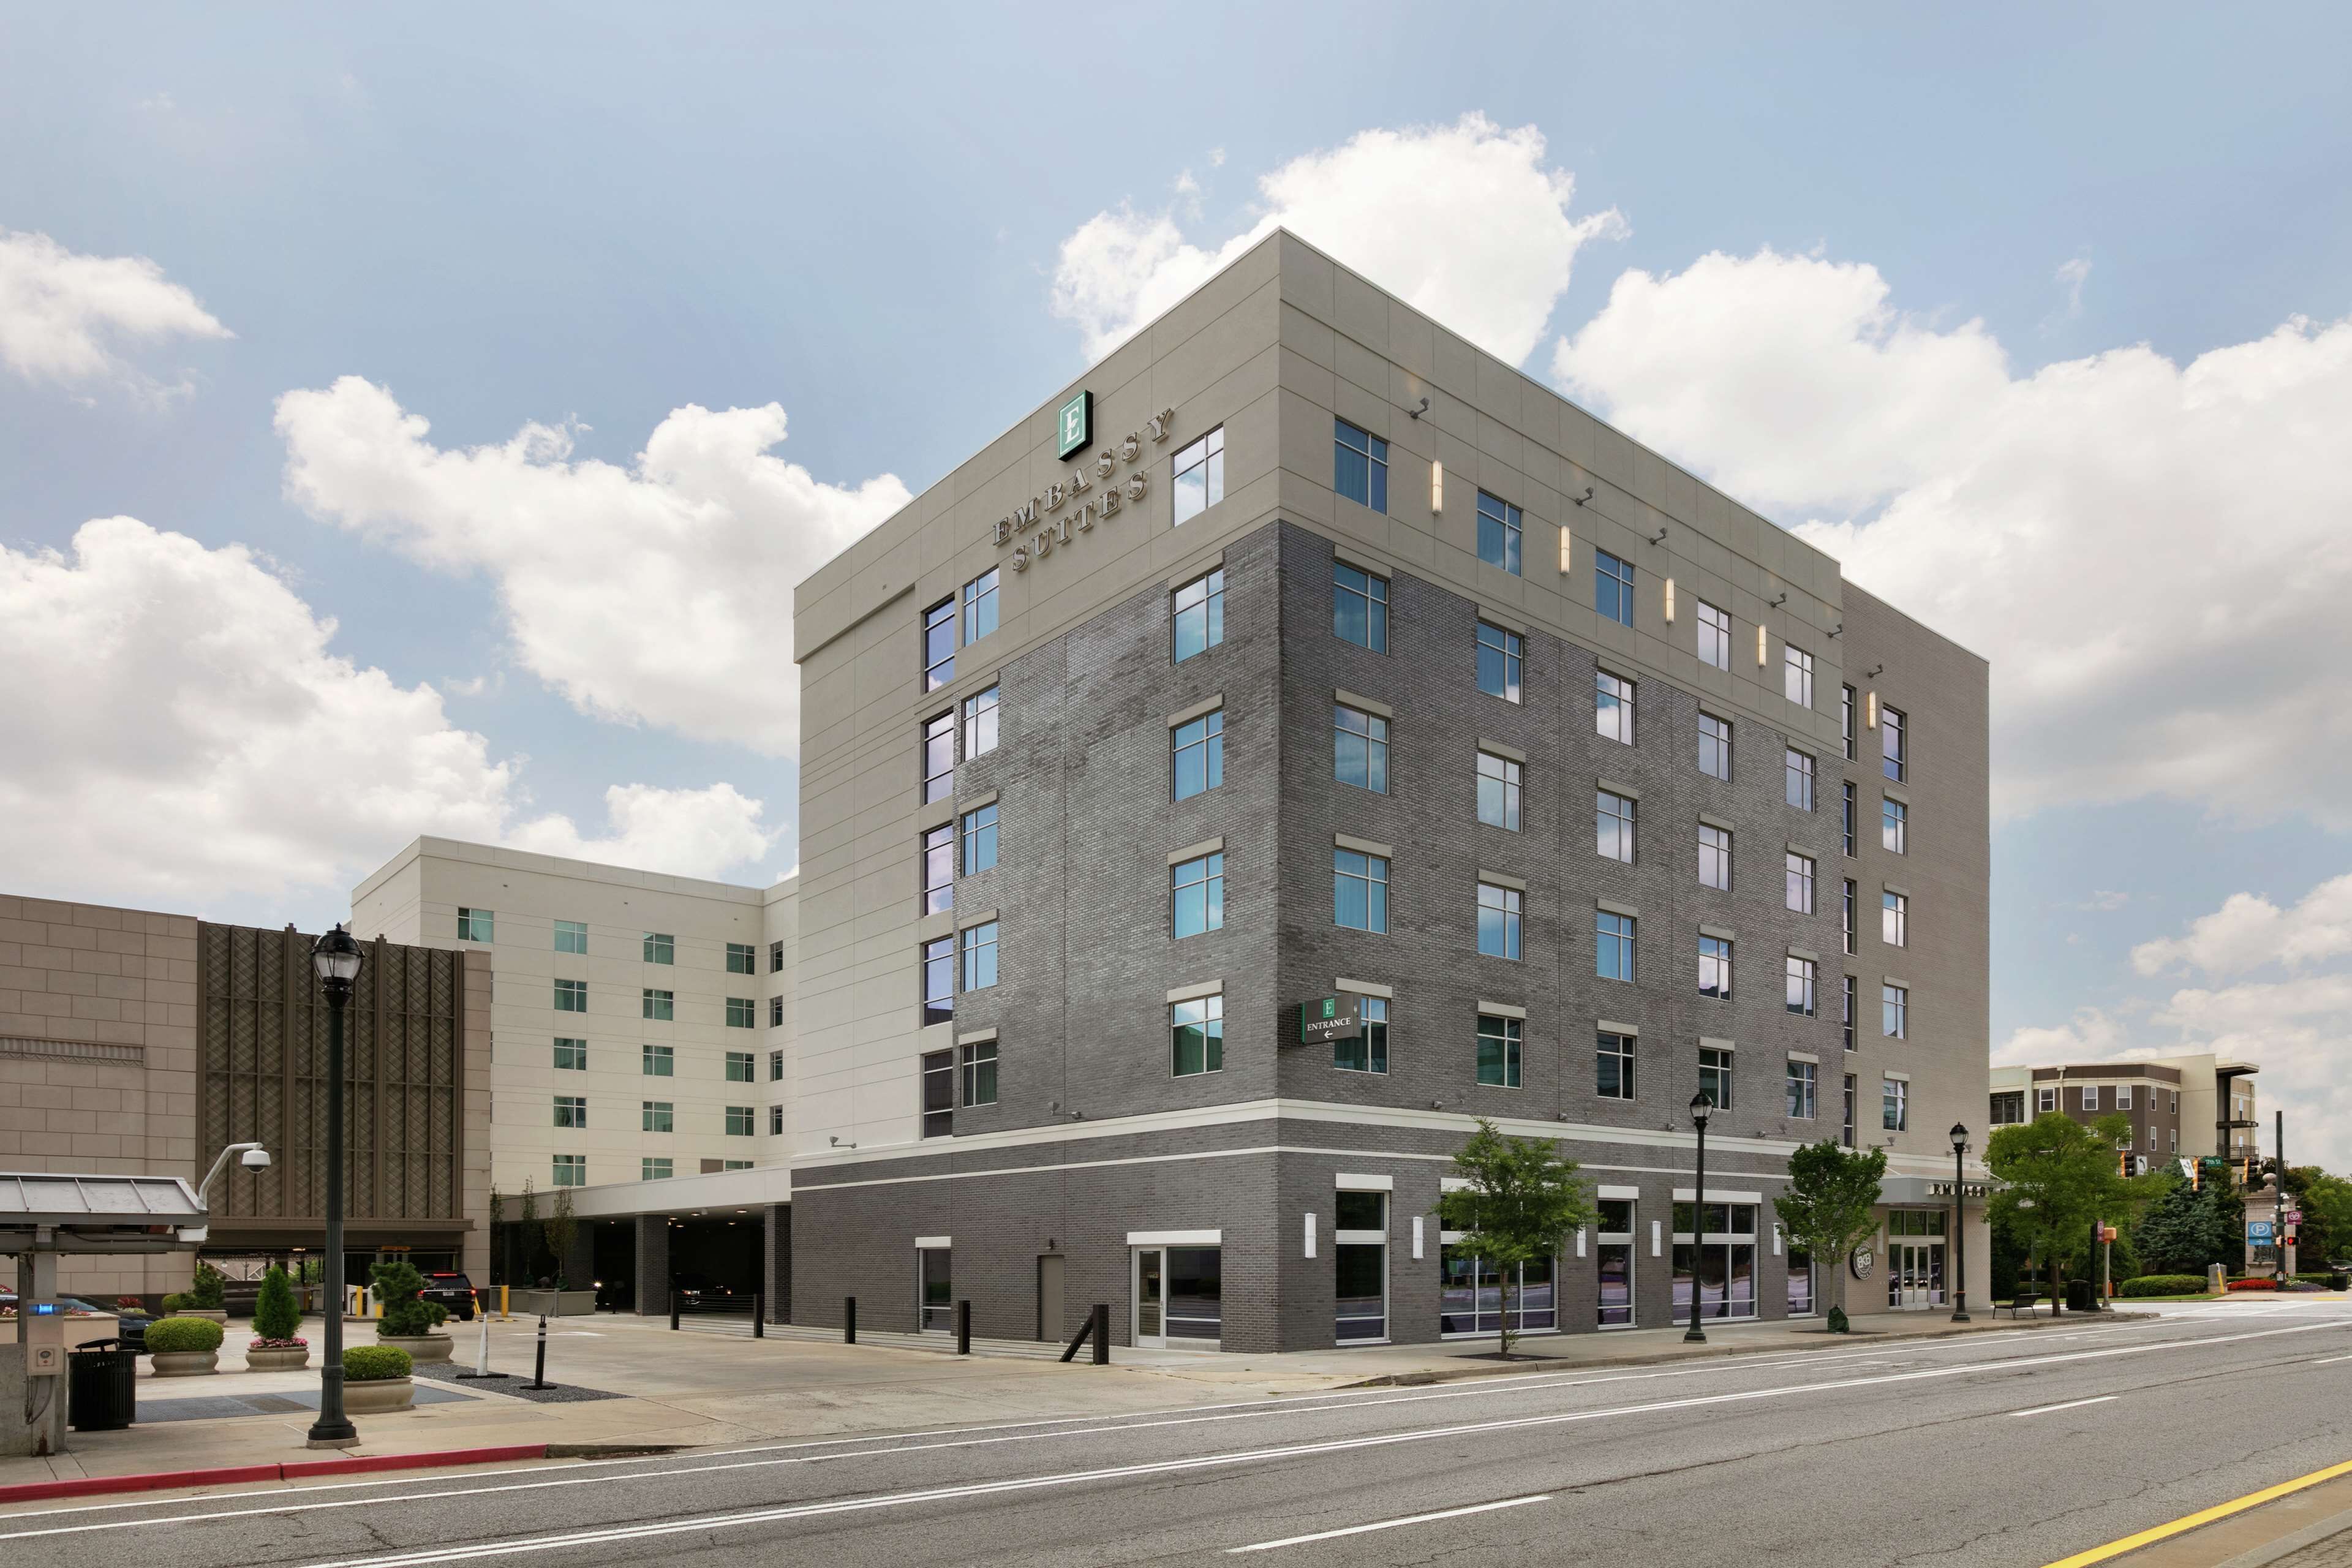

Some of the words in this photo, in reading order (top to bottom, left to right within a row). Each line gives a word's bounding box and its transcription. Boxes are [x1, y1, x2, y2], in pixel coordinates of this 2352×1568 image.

[1065, 407, 1079, 445] E
[992, 408, 1172, 546] EMBASSY
[1012, 470, 1147, 571] SUITES
[1307, 1017, 1351, 1031] ENTRANCE
[2256, 1225, 2265, 1234] P
